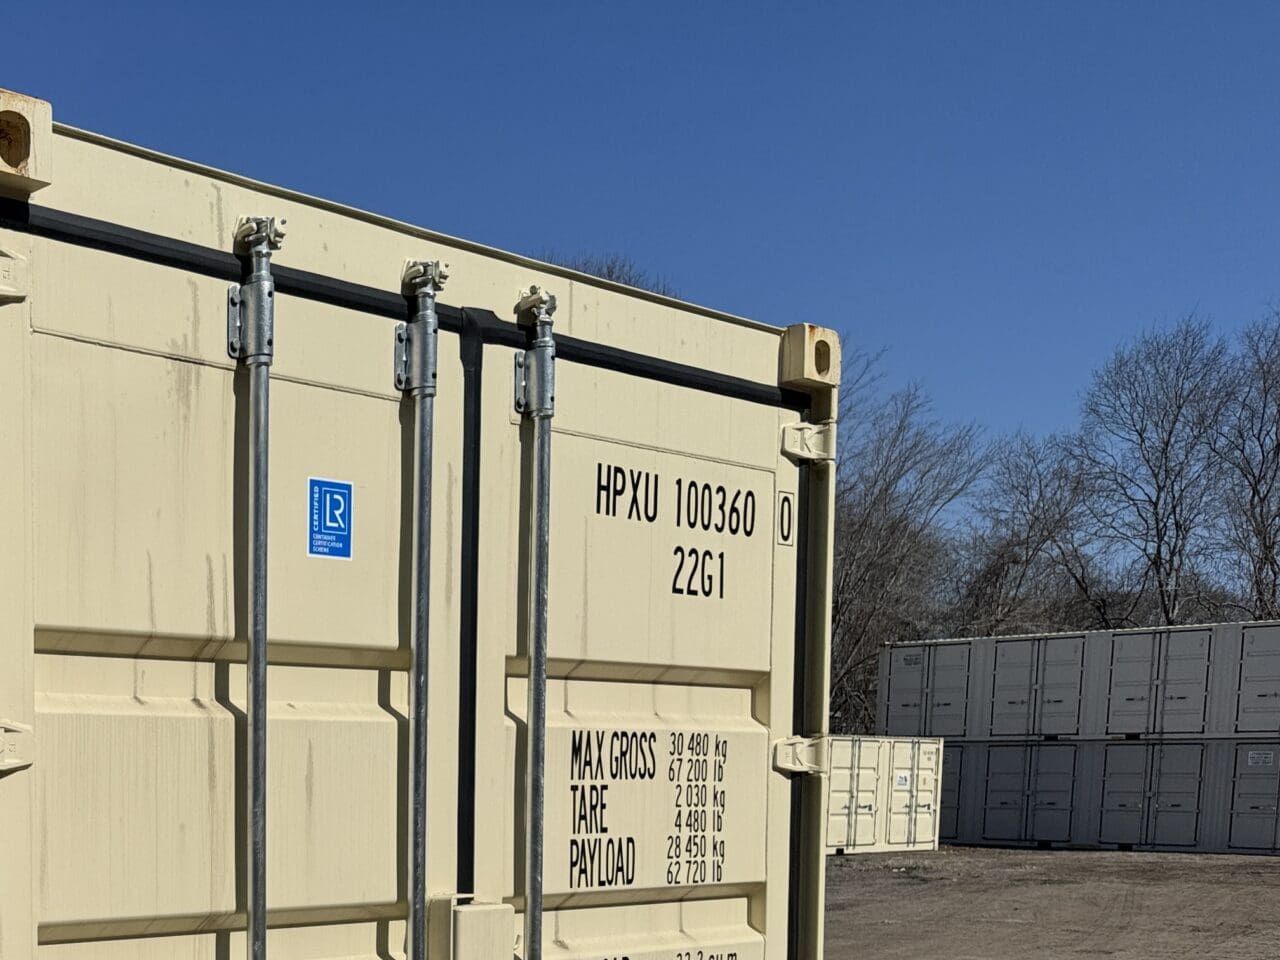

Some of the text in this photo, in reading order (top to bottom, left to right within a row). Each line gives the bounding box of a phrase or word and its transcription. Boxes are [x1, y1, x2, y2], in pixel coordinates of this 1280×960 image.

[596, 462, 791, 542] HPXU 100360 0
[672, 546, 724, 599] 22G1
[570, 730, 657, 781] MAX GROSS
[669, 732, 728, 764] 30 480 kg
[668, 758, 724, 782] 67 200 lb
[570, 784, 609, 834] TARE
[675, 784, 726, 815] 2 030 kg
[674, 809, 723, 833] 4 480 lb
[570, 837, 636, 889] PAYLOAD
[667, 835, 725, 865] 28 450 kg
[667, 860, 722, 885] 62 720 lb
